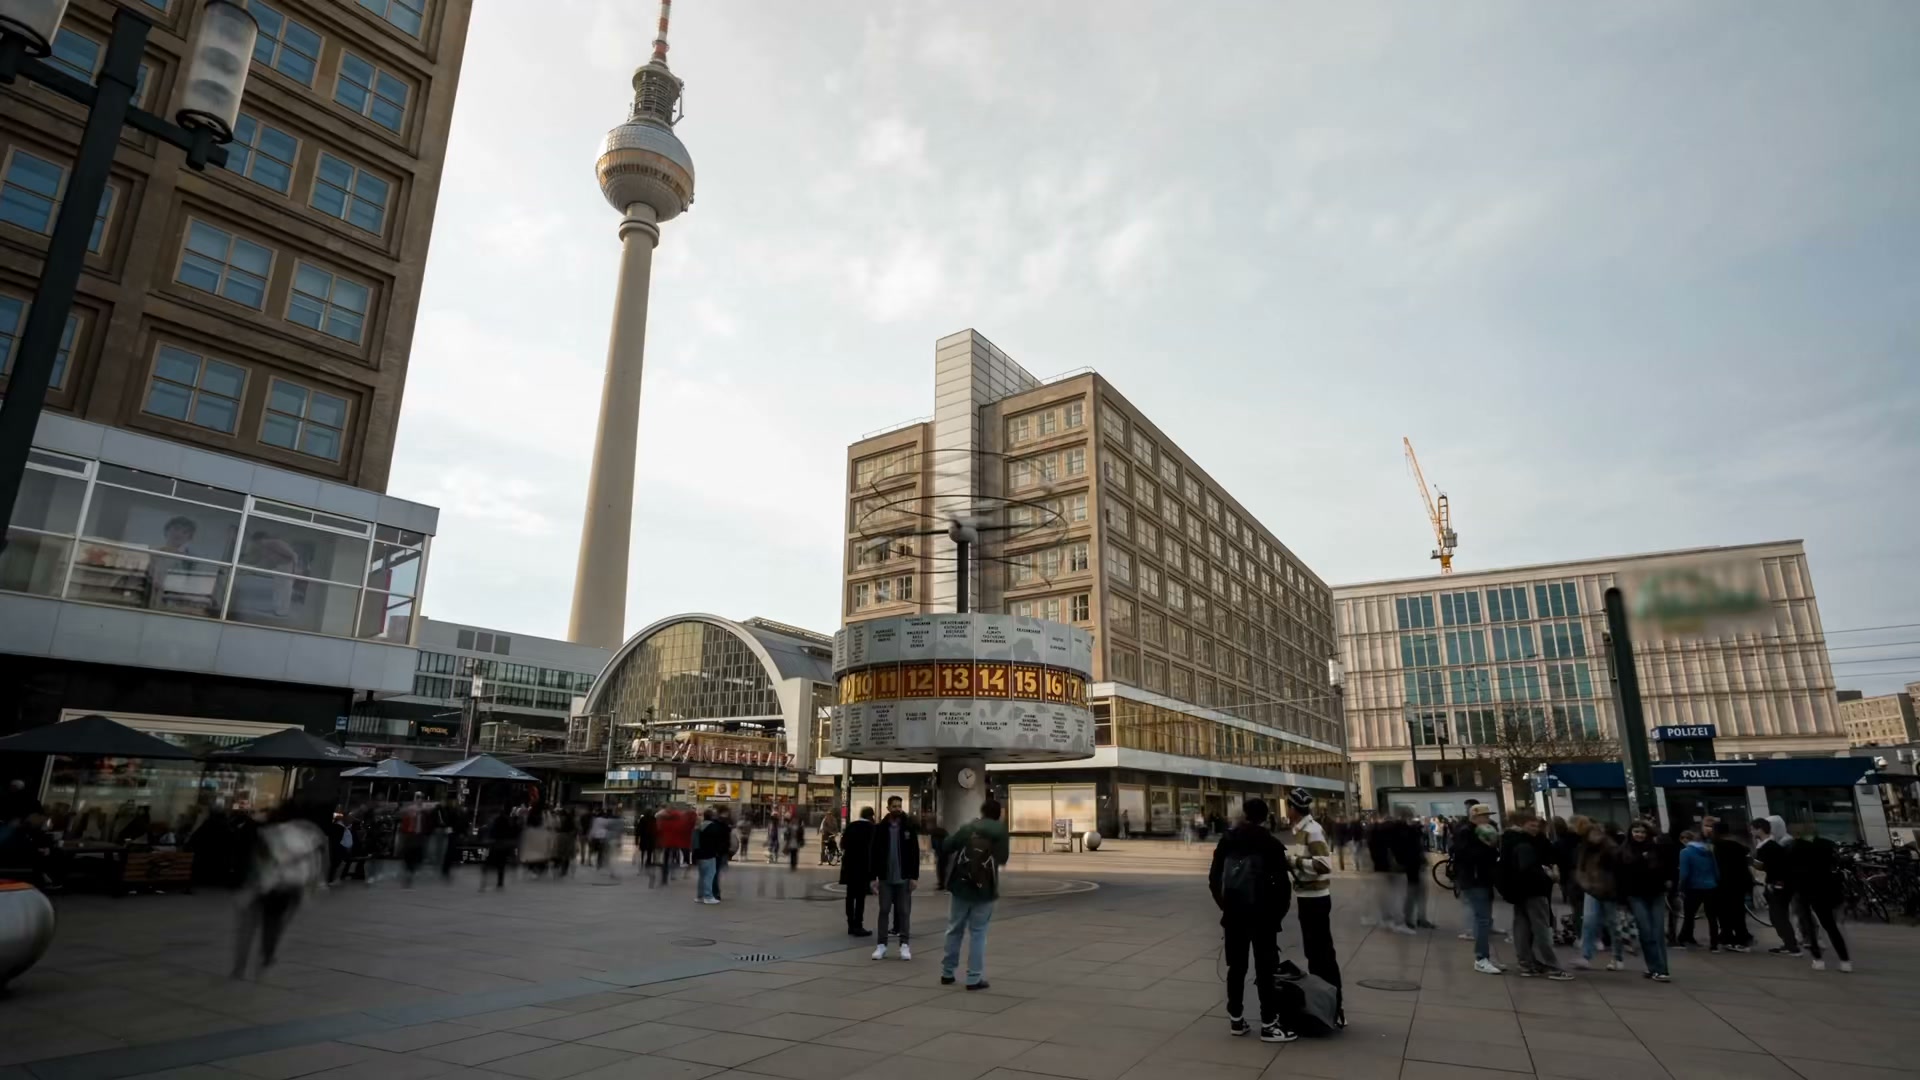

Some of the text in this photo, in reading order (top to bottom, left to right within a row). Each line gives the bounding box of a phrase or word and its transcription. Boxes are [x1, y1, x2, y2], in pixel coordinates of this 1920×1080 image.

[855, 675, 872, 696] 10
[880, 671, 897, 692] 11
[908, 669, 933, 690] 12
[942, 667, 969, 690] 13
[979, 668, 1005, 690] 14
[1014, 671, 1037, 693] 15
[1046, 673, 1063, 696] 16
[1667, 727, 1708, 736] POLIZEI
[633, 741, 795, 768] ALEXANDERPLATZ
[1682, 769, 1719, 778] POLIZEI
